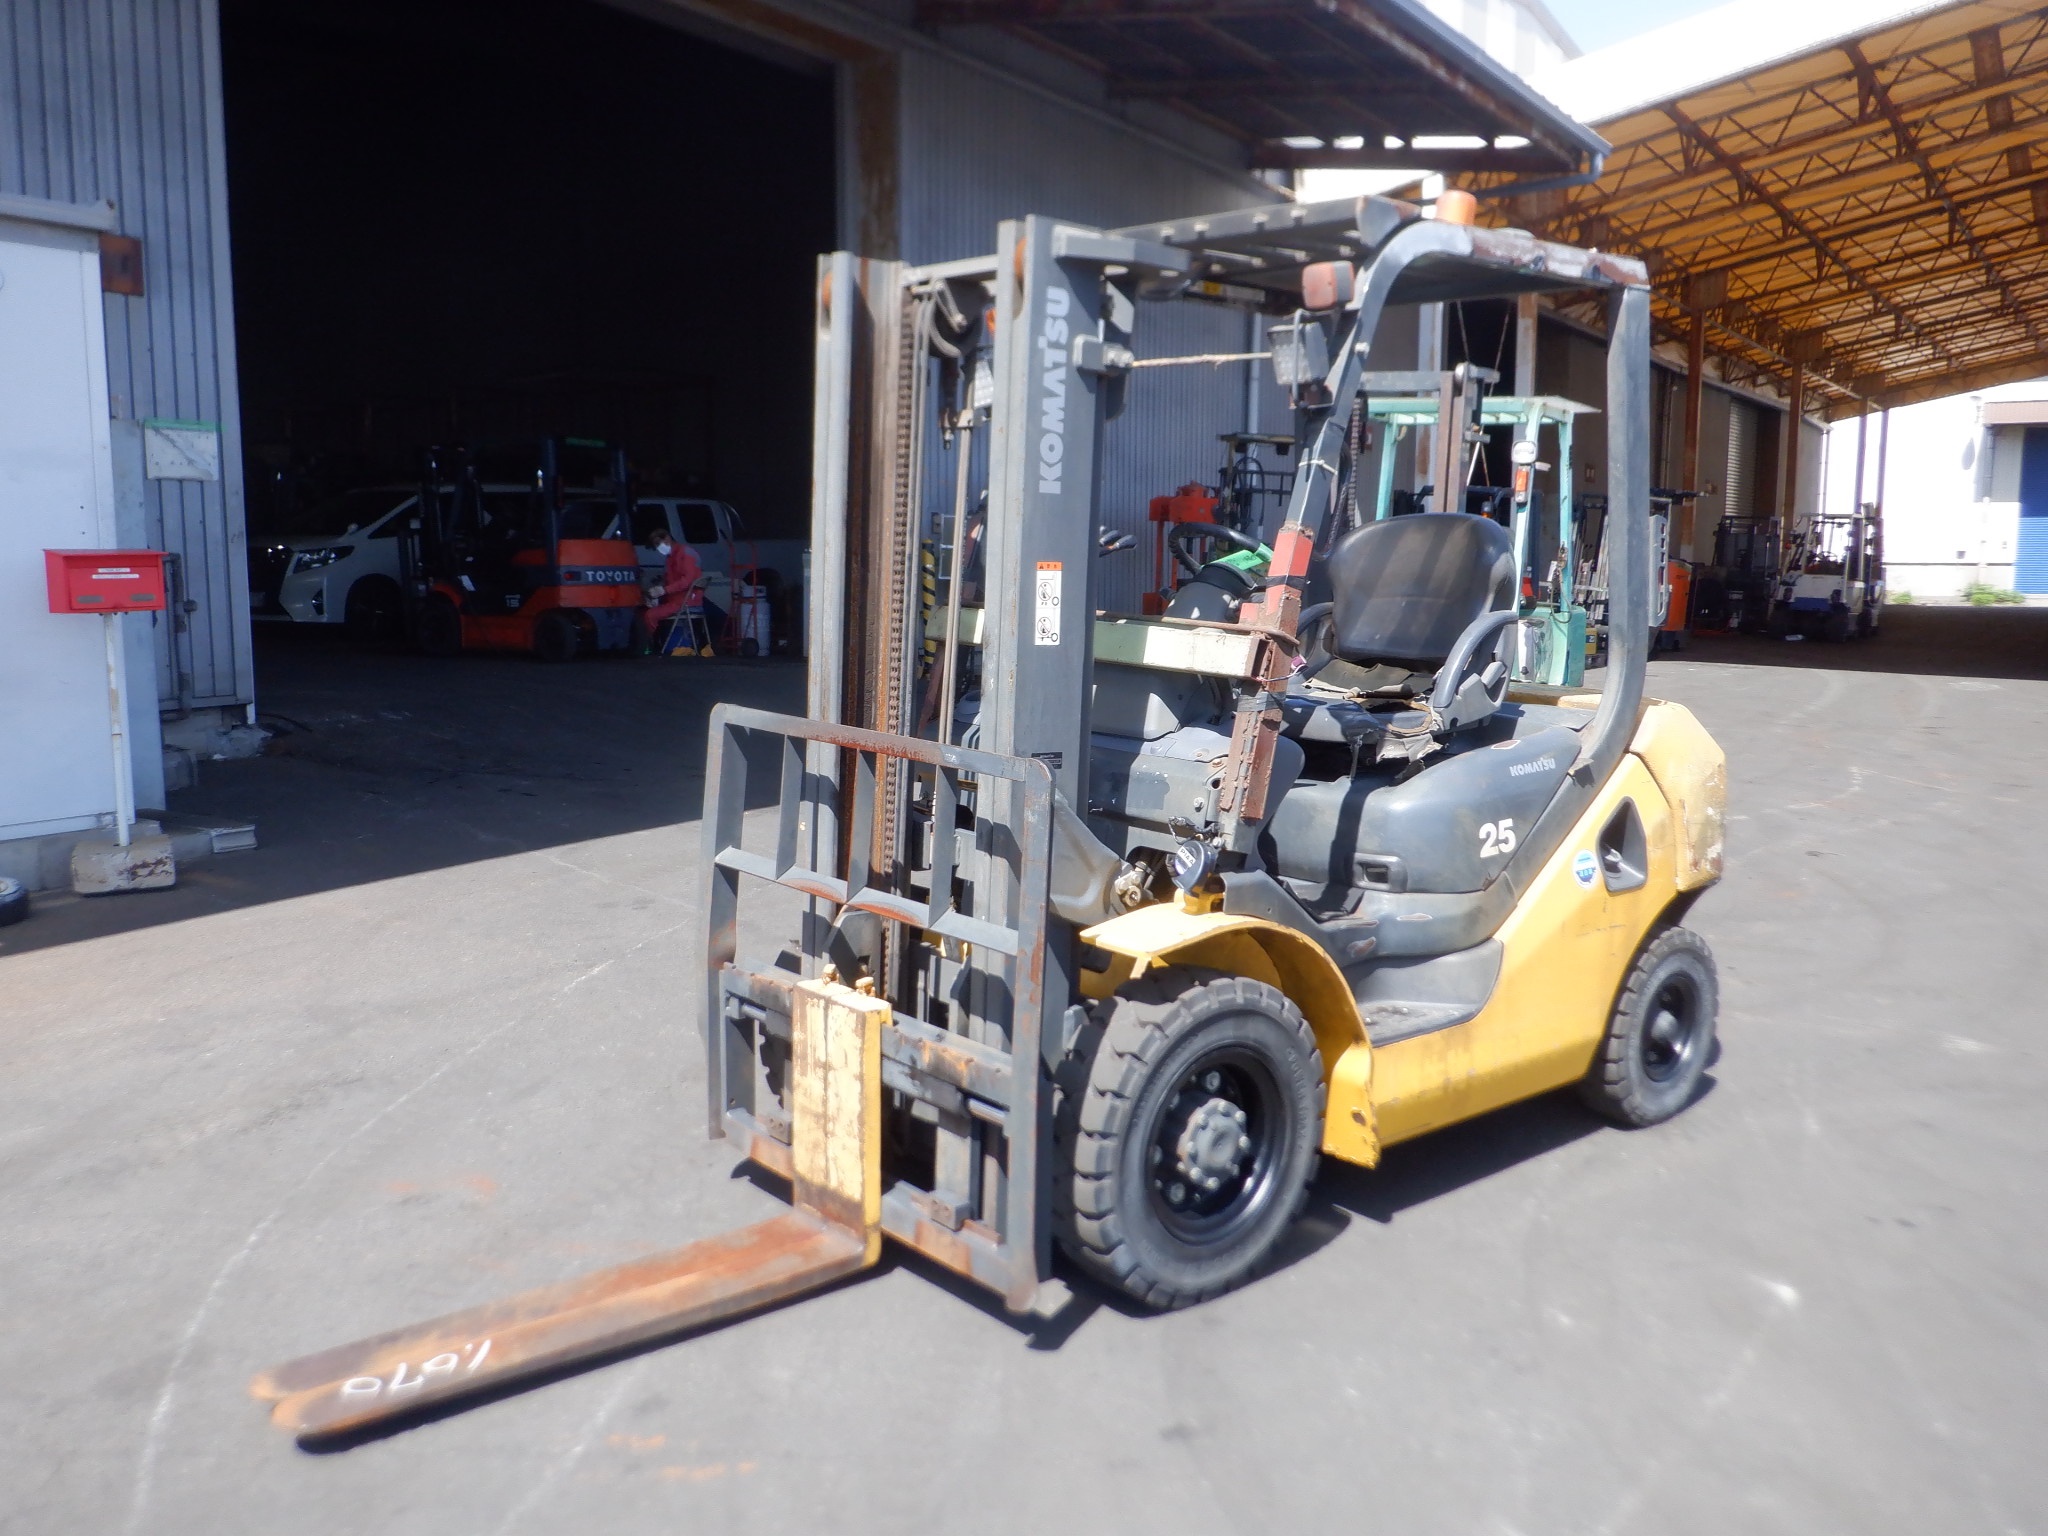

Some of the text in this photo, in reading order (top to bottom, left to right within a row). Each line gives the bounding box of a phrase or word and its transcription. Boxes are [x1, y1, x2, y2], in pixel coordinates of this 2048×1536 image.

[1038, 285, 1071, 495] KOMATSU
[586, 570, 636, 582] TOYOTA
[1509, 757, 1556, 777] KOMATSU
[1479, 818, 1516, 858] 25
